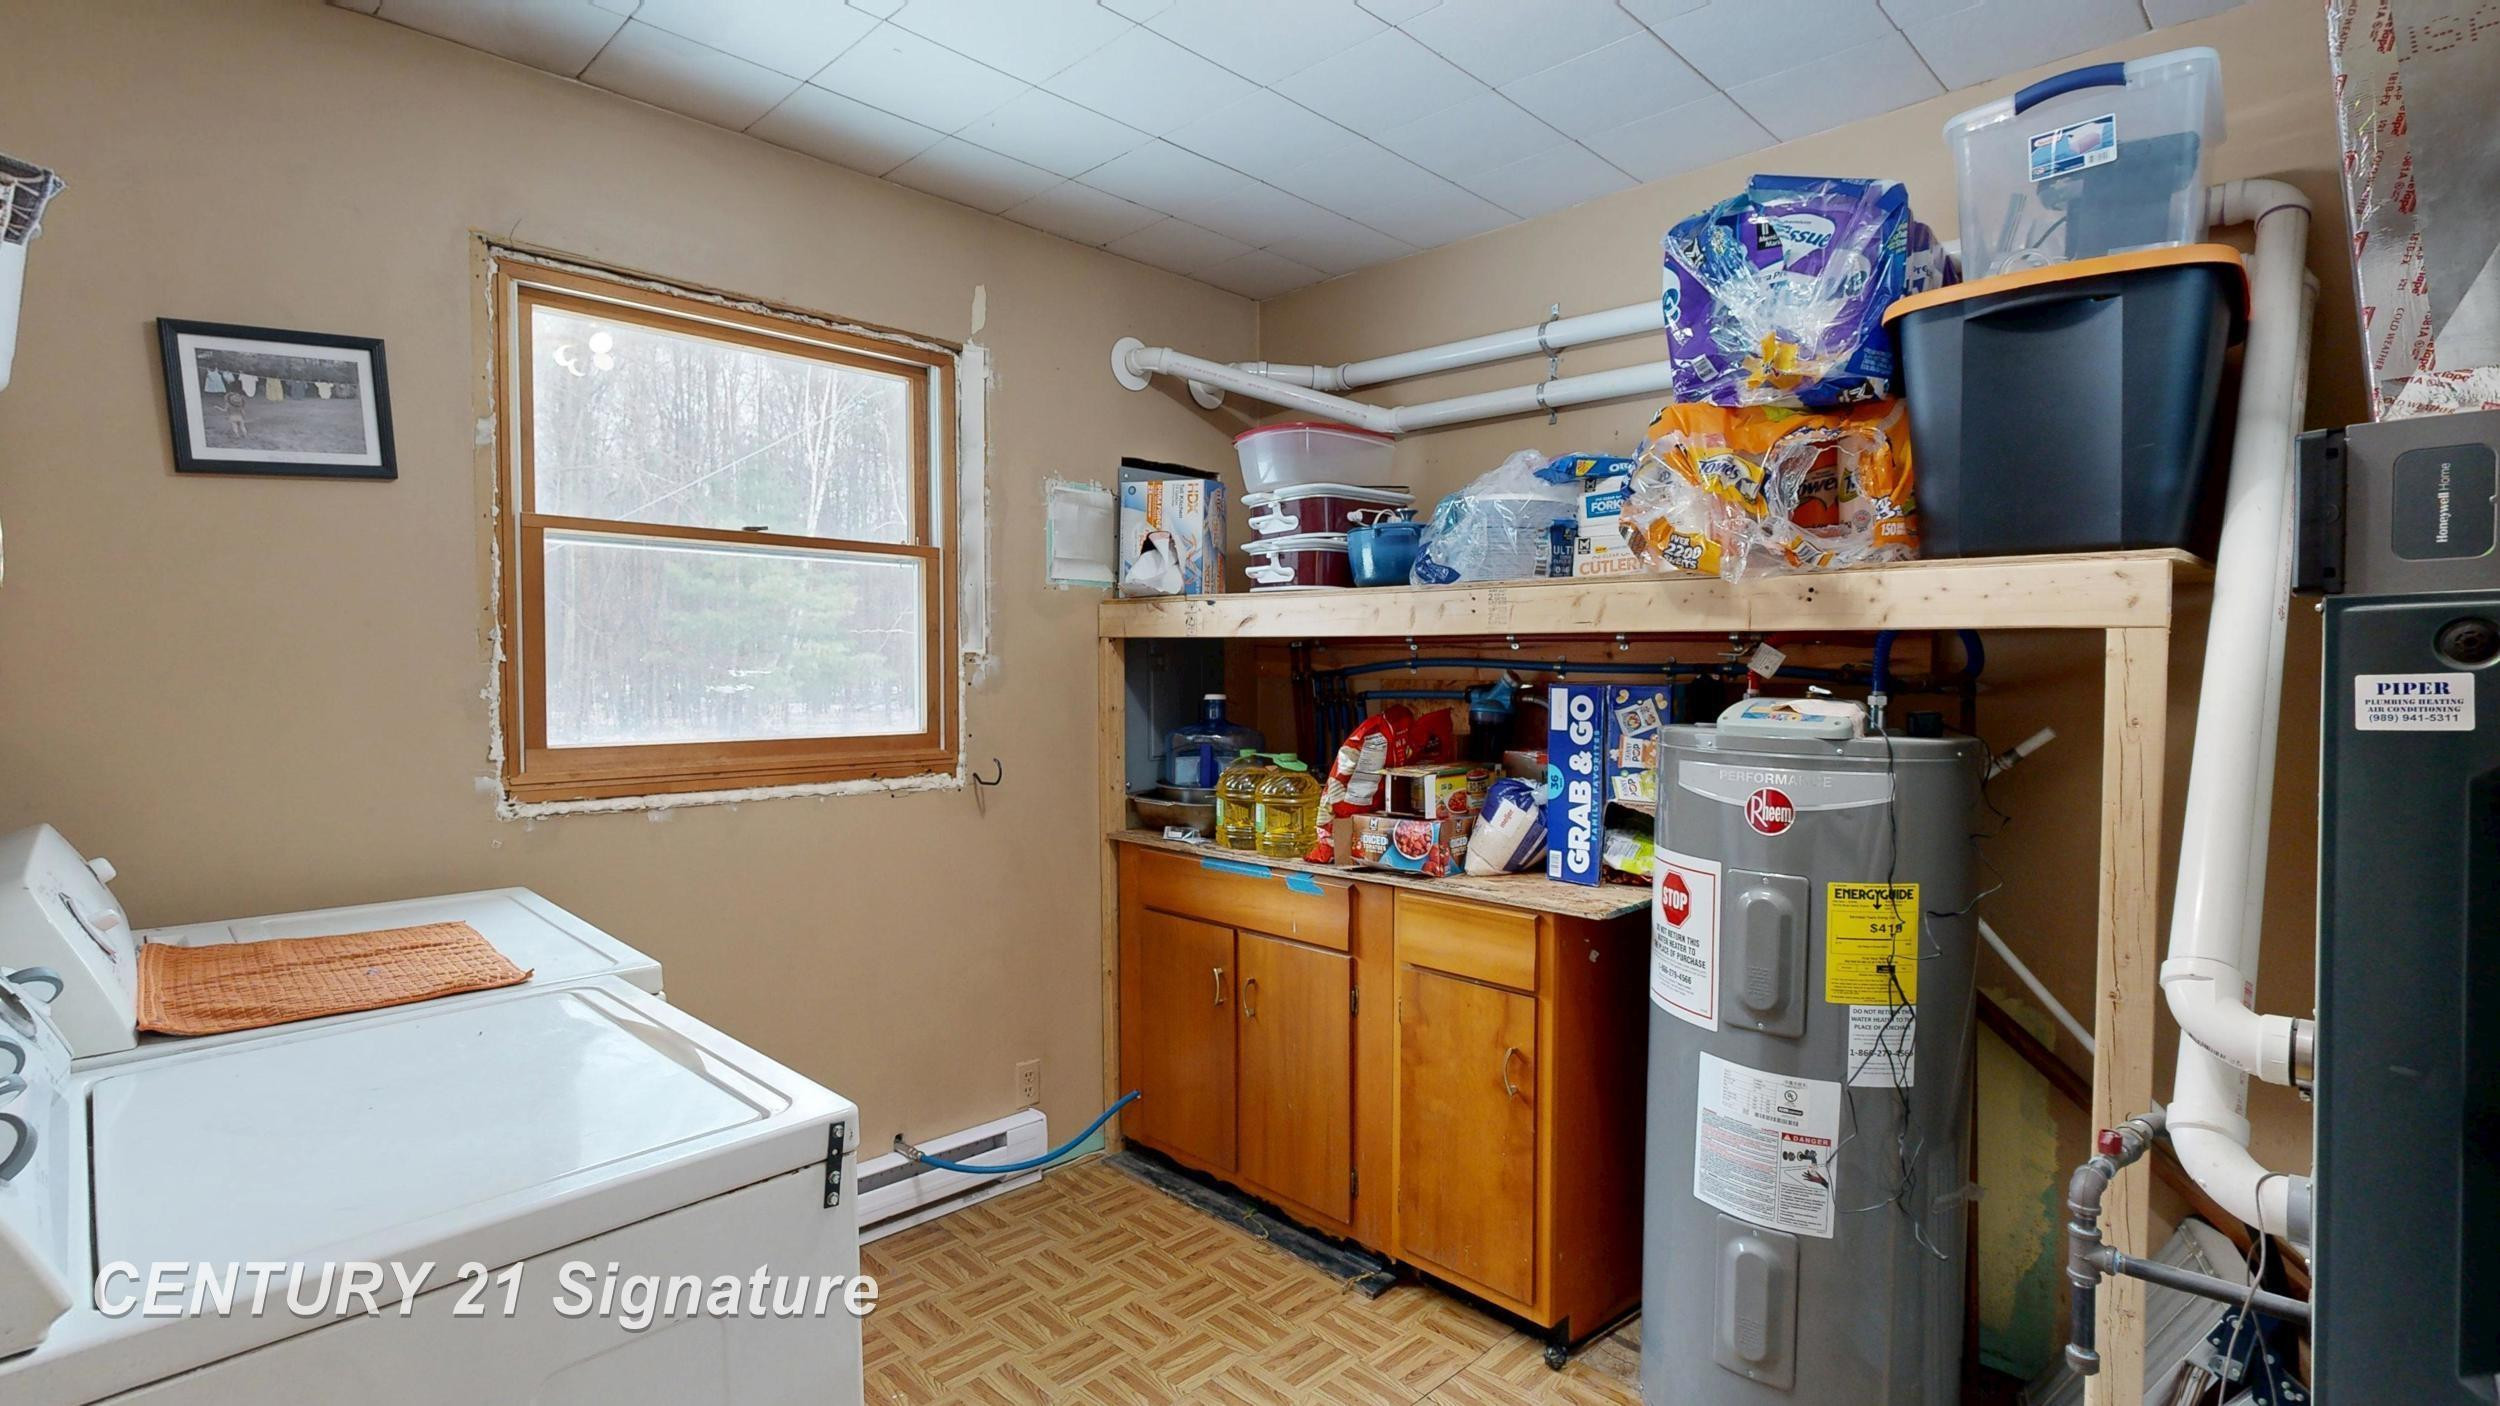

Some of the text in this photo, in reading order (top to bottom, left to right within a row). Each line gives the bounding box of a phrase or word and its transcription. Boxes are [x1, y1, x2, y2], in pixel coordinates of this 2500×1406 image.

[2375, 307, 2405, 370] COLD WEATHER
[1187, 483, 1199, 513] HDX
[2436, 463, 2452, 543] Honeywell Home
[2376, 682, 2451, 696] PIPER
[2369, 713, 2459, 723] (989) 941-5311
[1632, 744, 1641, 762] POP
[1551, 775, 1559, 790] 36
[1567, 695, 1594, 874] GRAB & GO
[1591, 730, 1600, 841] FAMILY FAVORITES
[1719, 769, 1833, 788] PERFORMAE
[1751, 789, 1793, 828] Rheem
[1663, 886, 1688, 911] STOP
[1834, 888, 1914, 901] ENERGYGUIDE
[1668, 929, 1686, 943] RETURN
[1687, 935, 1700, 948] THIS
[1669, 938, 1687, 954] HEATER
[1688, 946, 1696, 956] TO
[1670, 949, 1676, 959] OF
[1677, 951, 1706, 970] PURCHASE
[1793, 1136, 1829, 1146] DANGER
